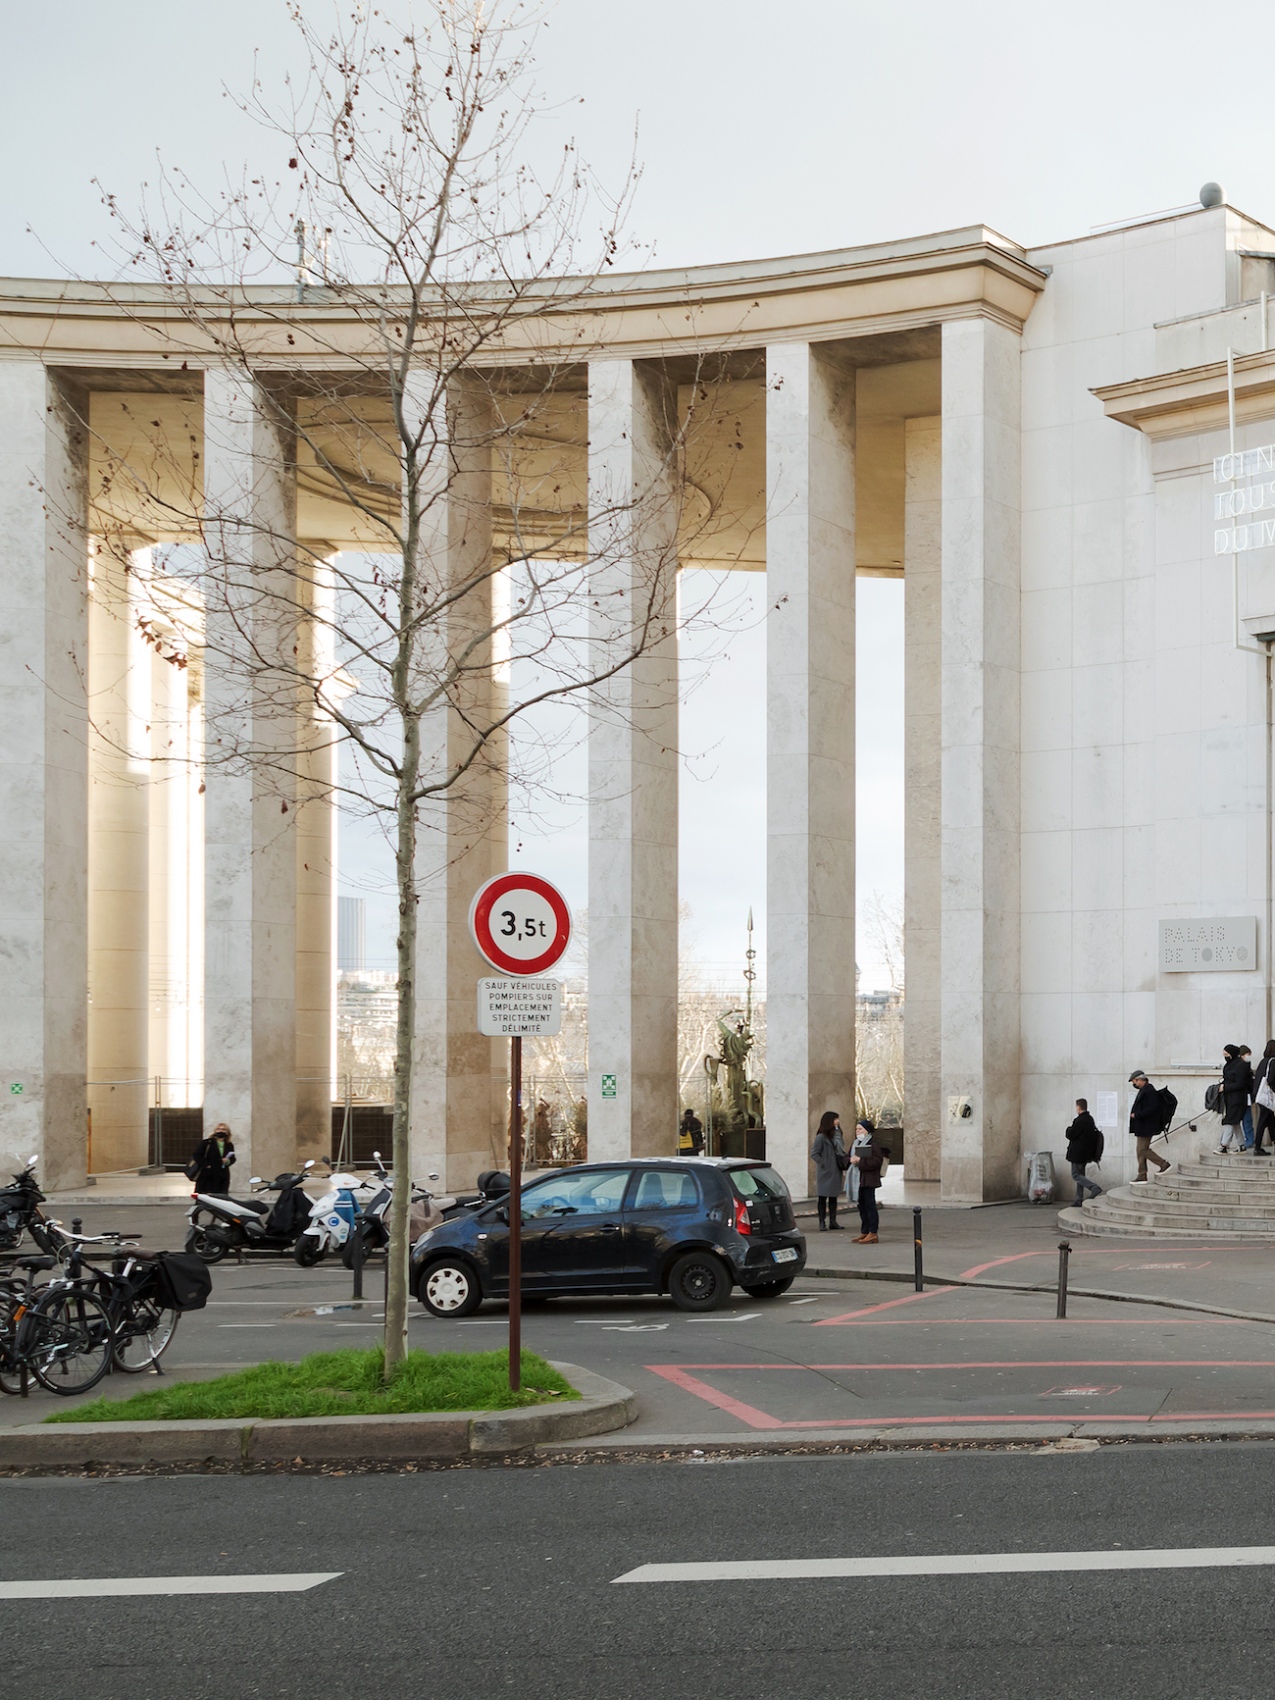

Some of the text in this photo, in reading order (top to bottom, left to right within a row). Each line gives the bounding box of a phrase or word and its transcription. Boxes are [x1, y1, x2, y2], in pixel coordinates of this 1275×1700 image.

[1213, 453, 1244, 483] ICI
[1215, 526, 1248, 555] DU
[1165, 926, 1225, 943] PALAIS
[1165, 948, 1184, 963] DE
[485, 980, 557, 991] SAUF VÉHICULES
[489, 992, 553, 1001] POMPIERS SUR
[489, 1003, 553, 1011] EMPLACEMENT
[492, 1014, 550, 1022] STRICTEMENT
[502, 1023, 541, 1032] DÉLIMITÉ
